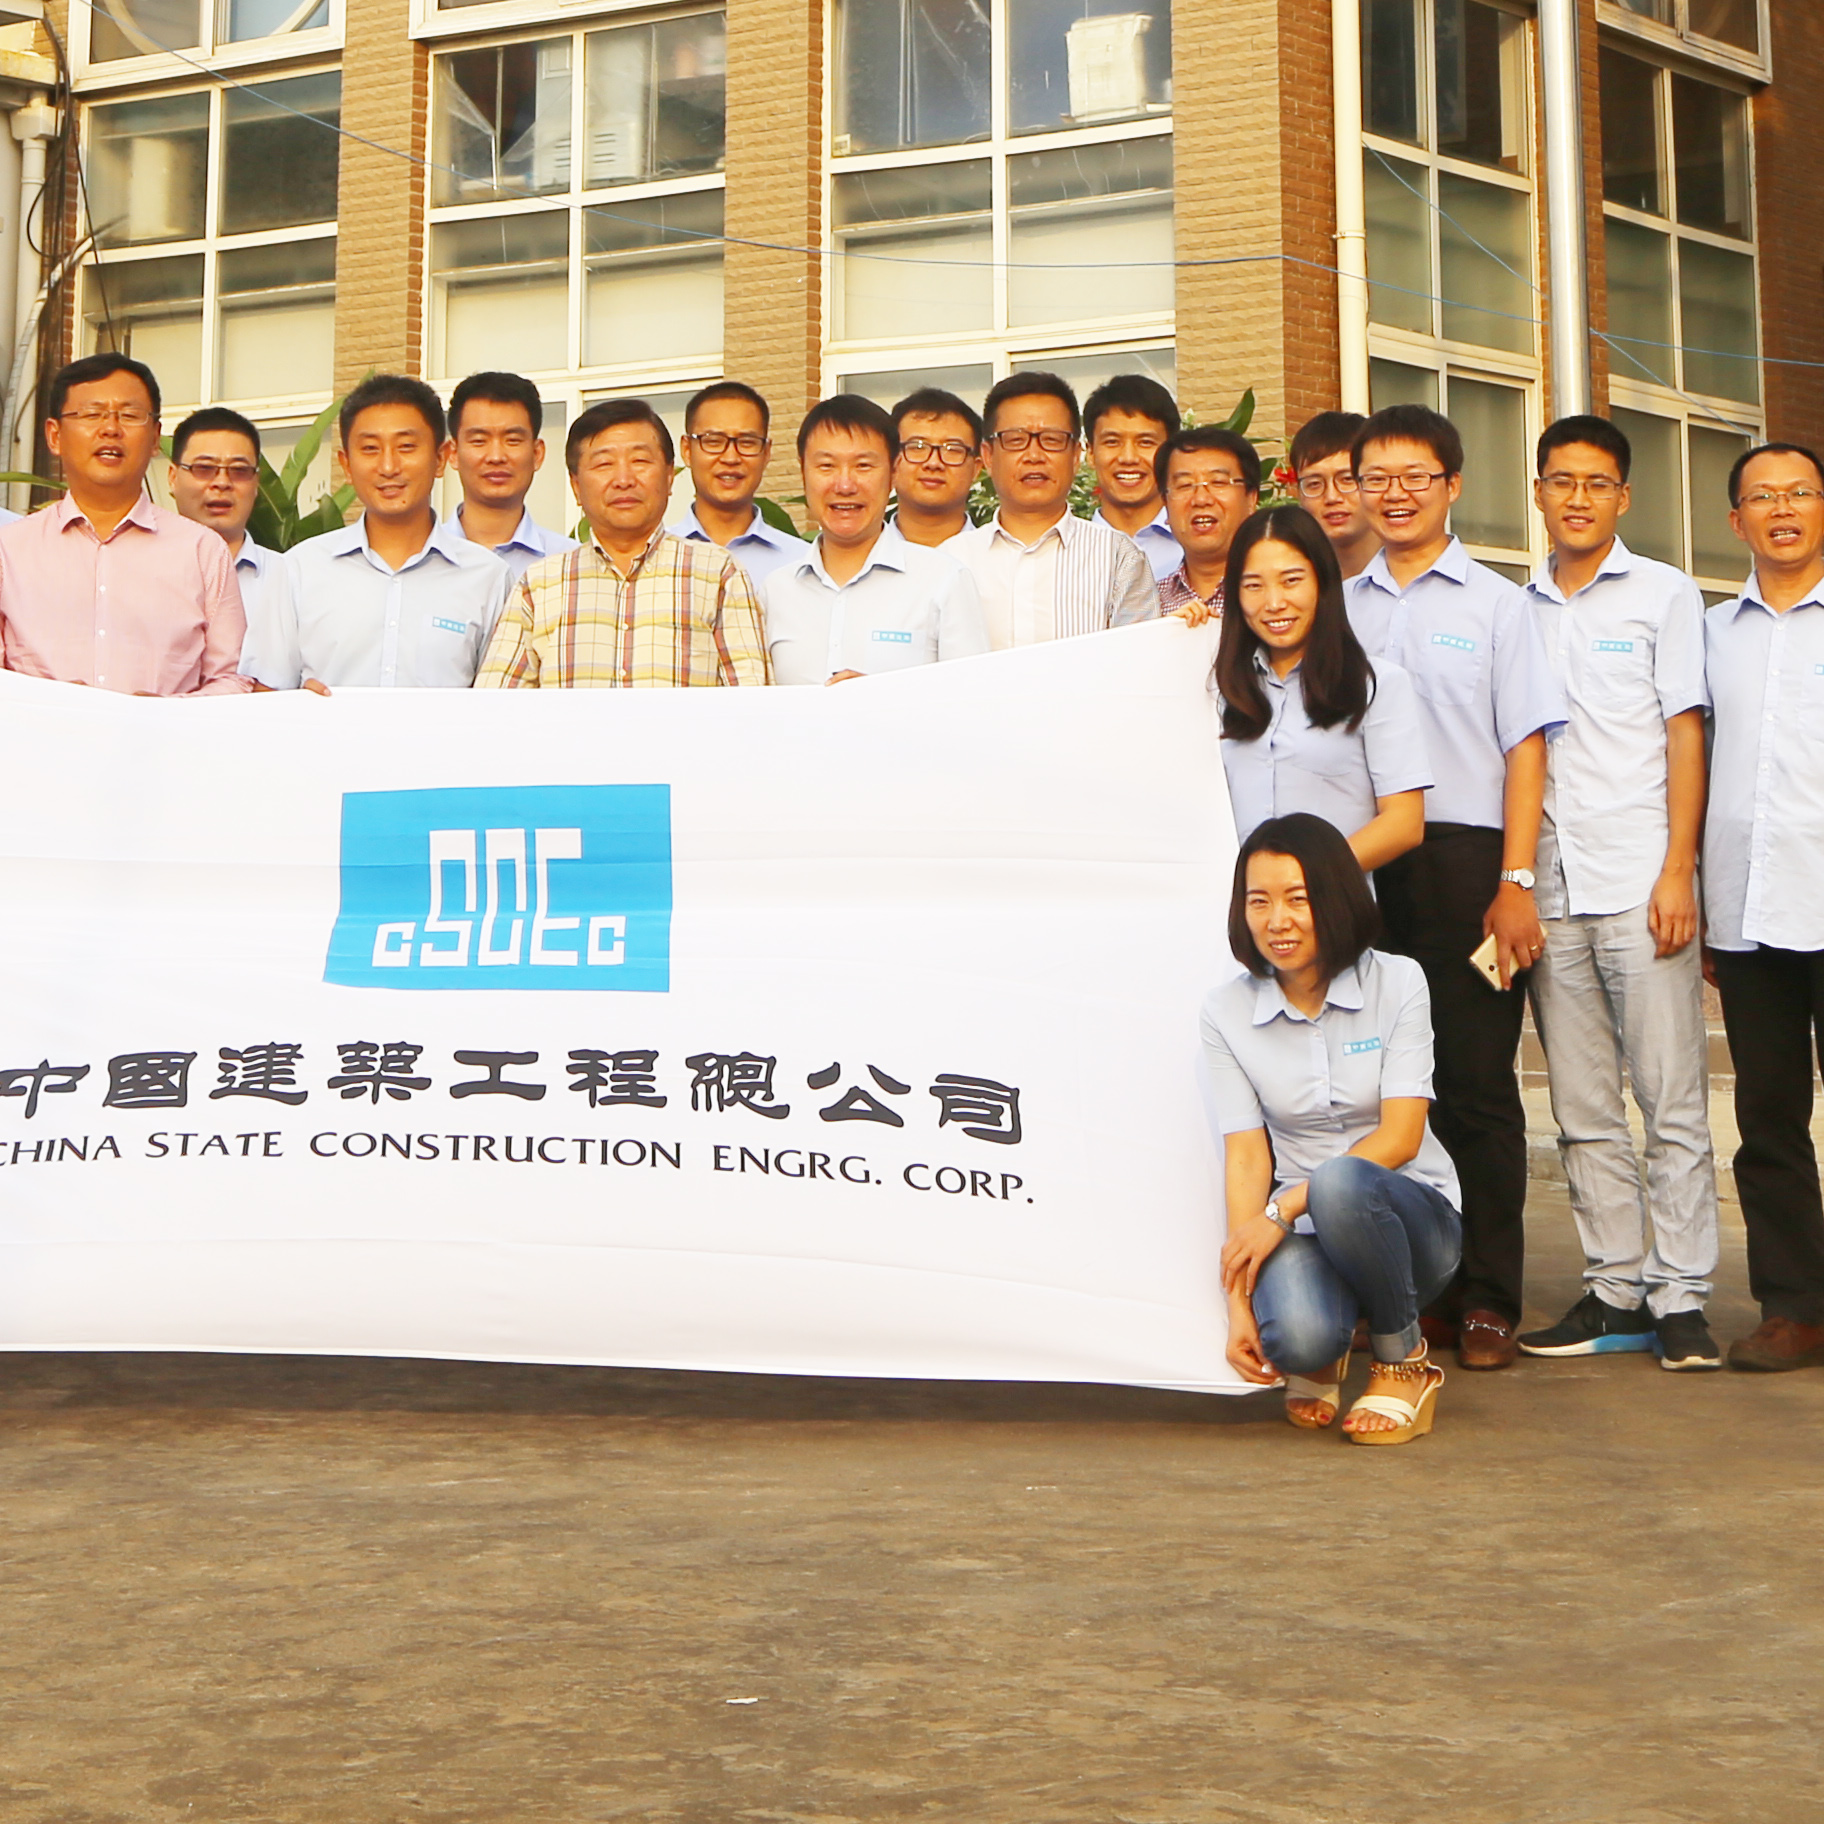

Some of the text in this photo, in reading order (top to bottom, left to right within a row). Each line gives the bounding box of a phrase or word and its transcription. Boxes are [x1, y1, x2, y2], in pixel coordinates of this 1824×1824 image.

[145, 1131, 283, 1158] STATE
[309, 1131, 681, 1169] CONSTRUCTION
[713, 1144, 882, 1185] ENGRG.
[903, 1163, 1034, 1204] CORP.
